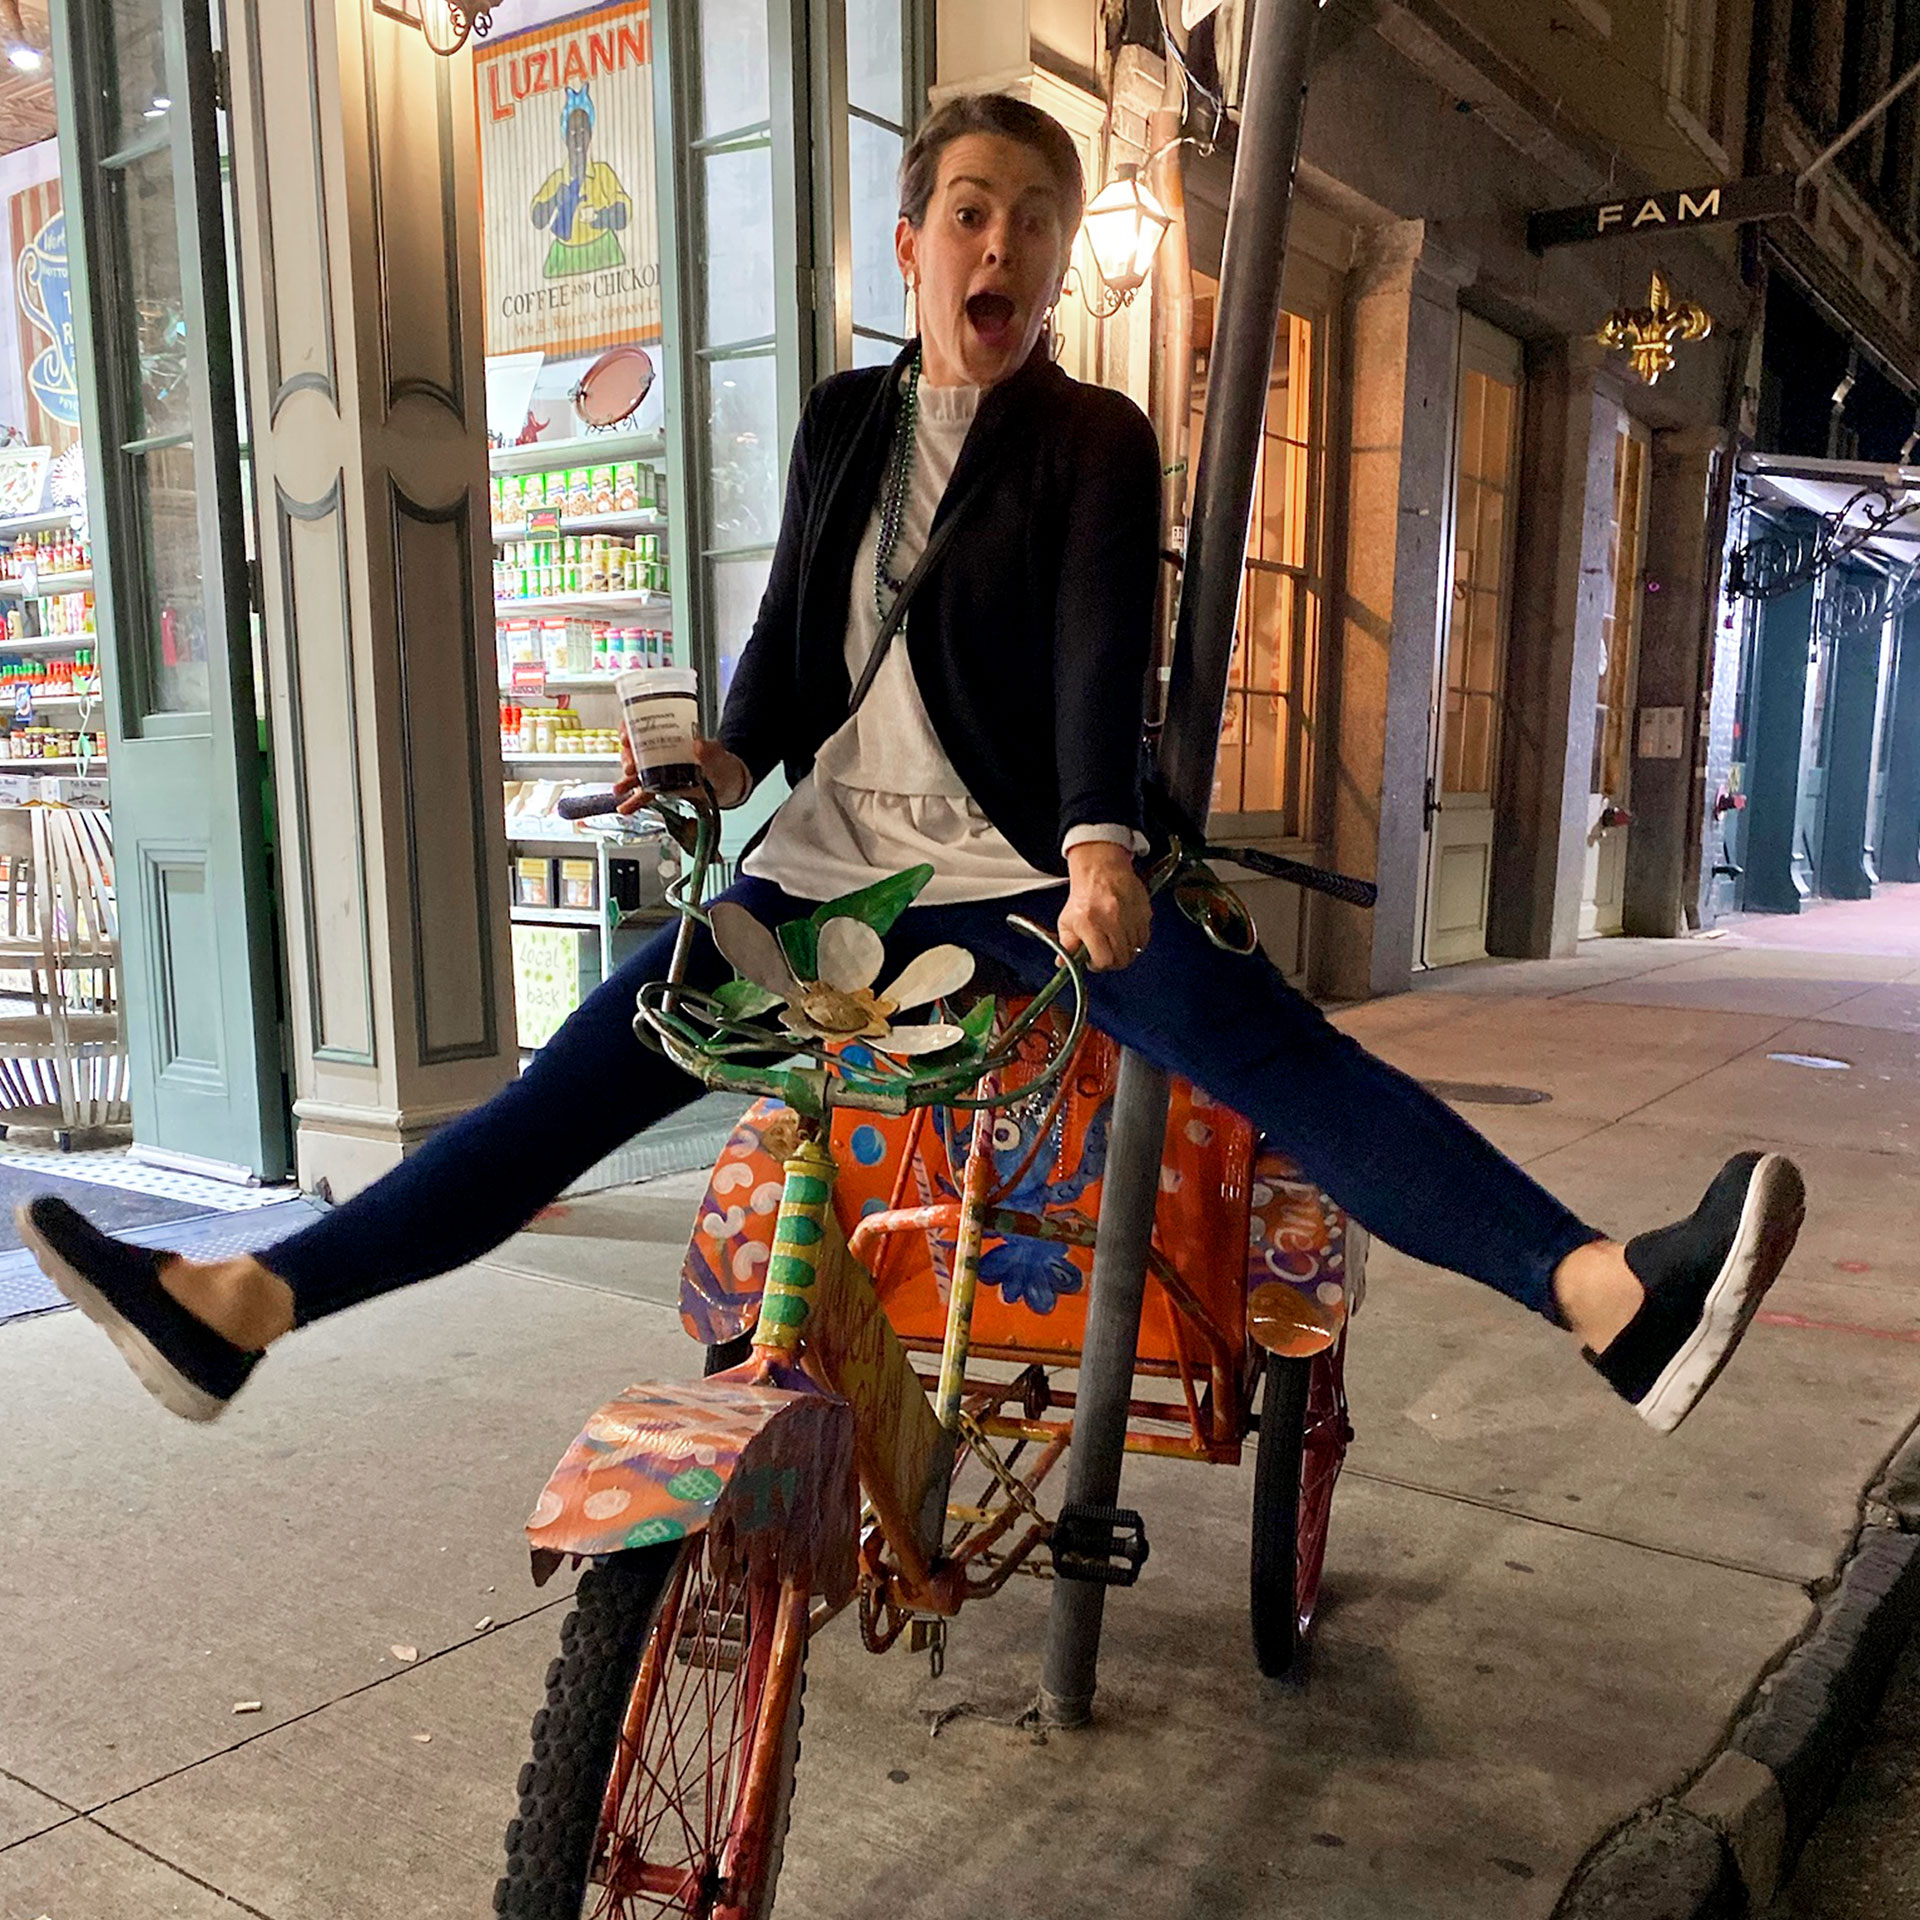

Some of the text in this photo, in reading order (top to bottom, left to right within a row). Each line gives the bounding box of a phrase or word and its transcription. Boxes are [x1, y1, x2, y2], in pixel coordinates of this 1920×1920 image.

[488, 19, 652, 122] LUZIANN
[1597, 188, 1720, 232] FAM
[502, 283, 571, 318] COFFEE
[572, 282, 592, 297] AND
[1264, 1170, 1320, 1283] Cand
